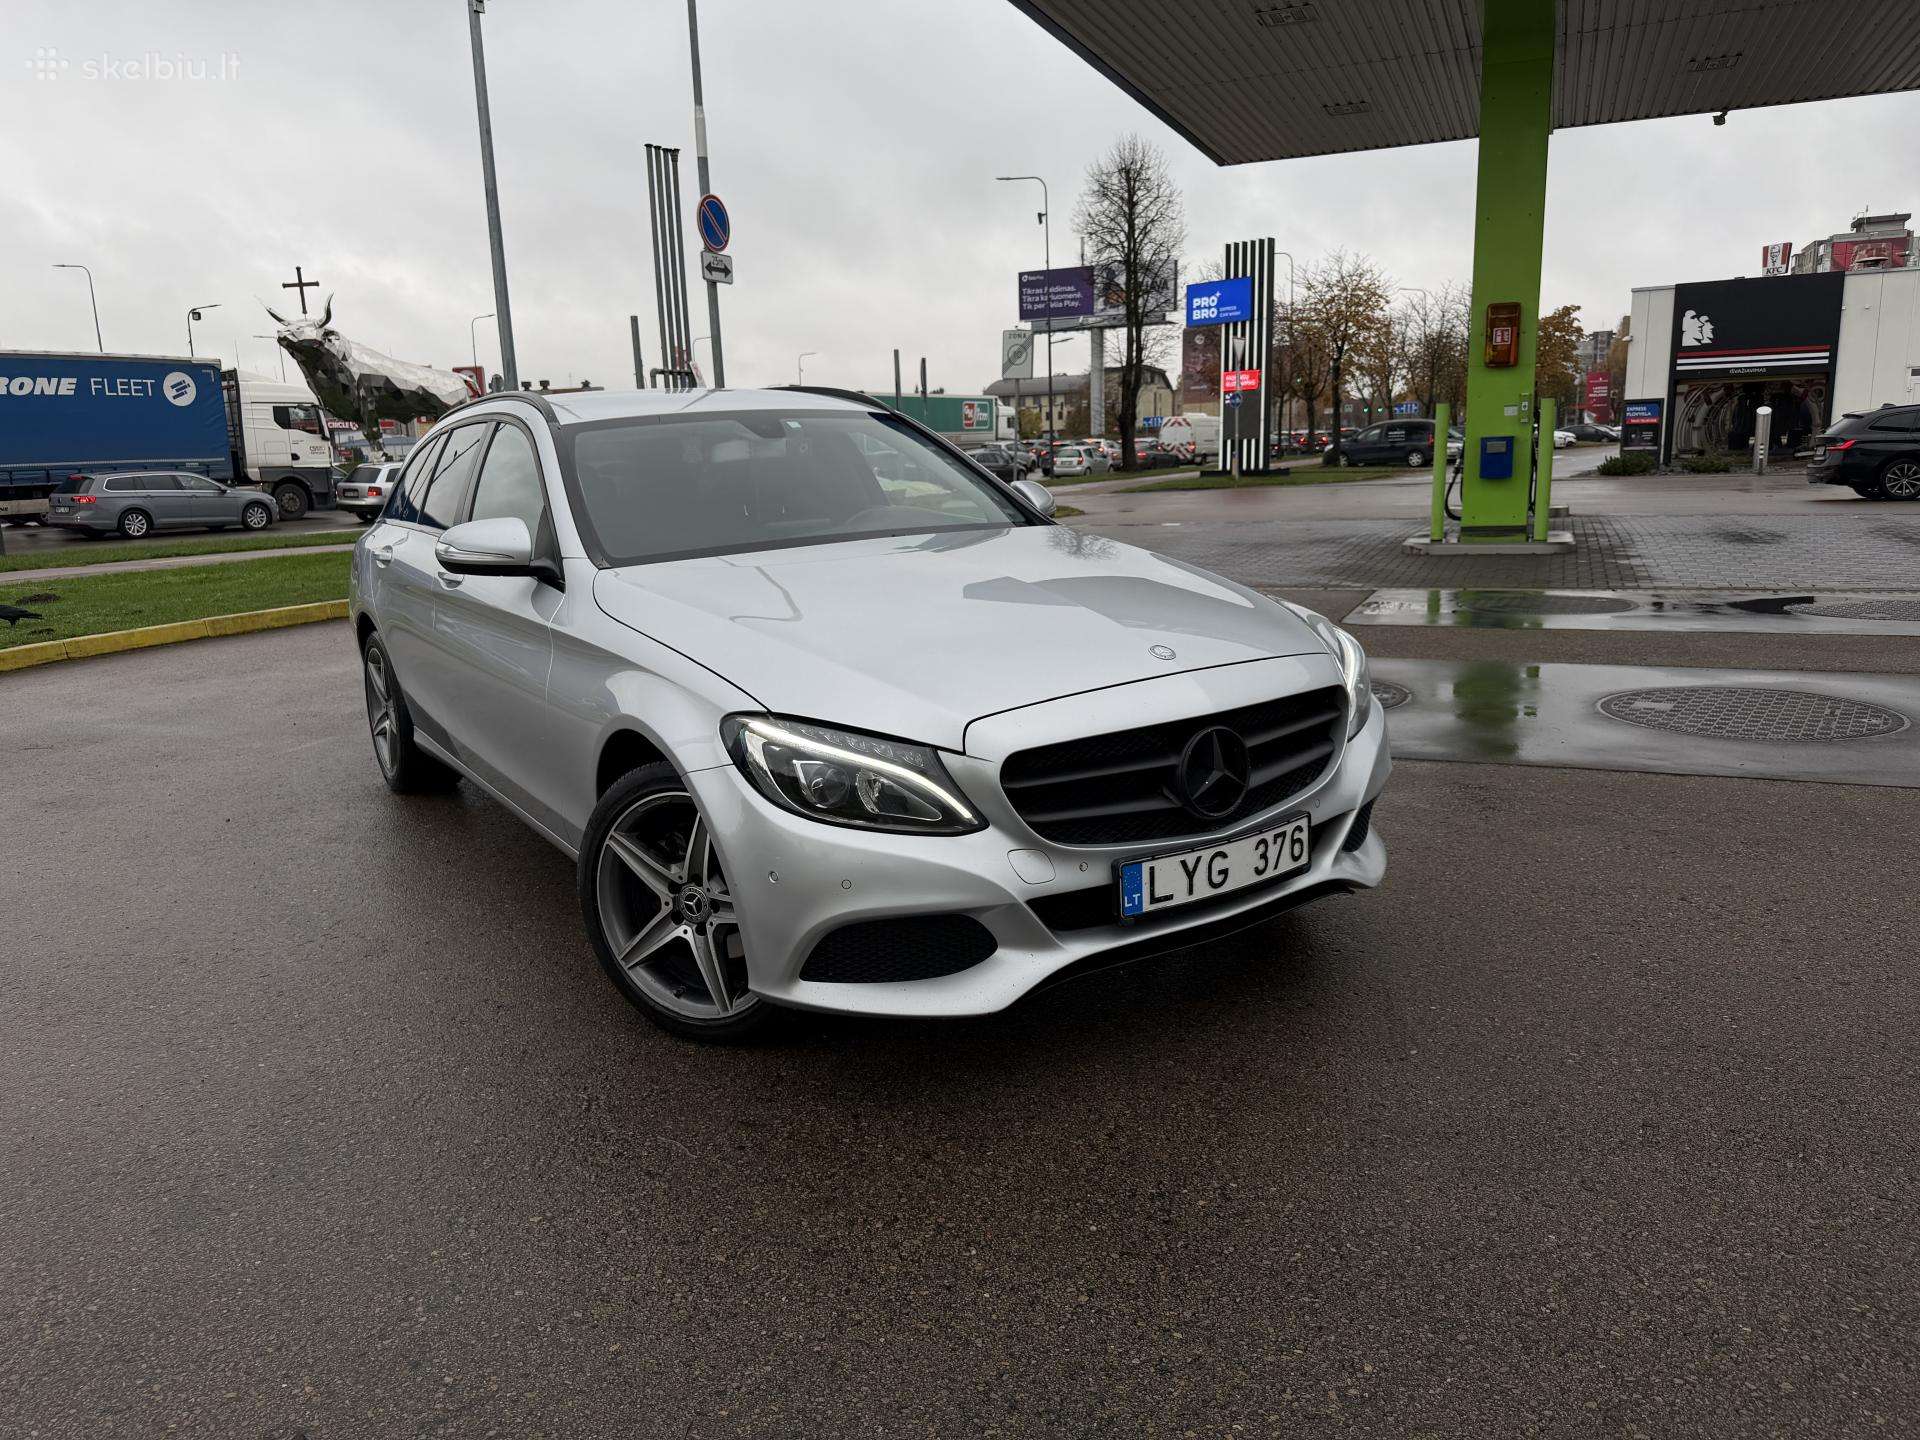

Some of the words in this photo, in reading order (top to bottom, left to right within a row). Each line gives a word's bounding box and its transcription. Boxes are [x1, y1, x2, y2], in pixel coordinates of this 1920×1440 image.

[1766, 266, 1783, 275] KFC
[1192, 296, 1218, 308] PRO
[1192, 308, 1218, 320] BRO
[90, 377, 156, 397] FLEET
[327, 421, 350, 429] CIRCLE
[1149, 850, 1229, 905] LYG
[1254, 825, 1304, 876] 376
[1124, 893, 1140, 907] LT
